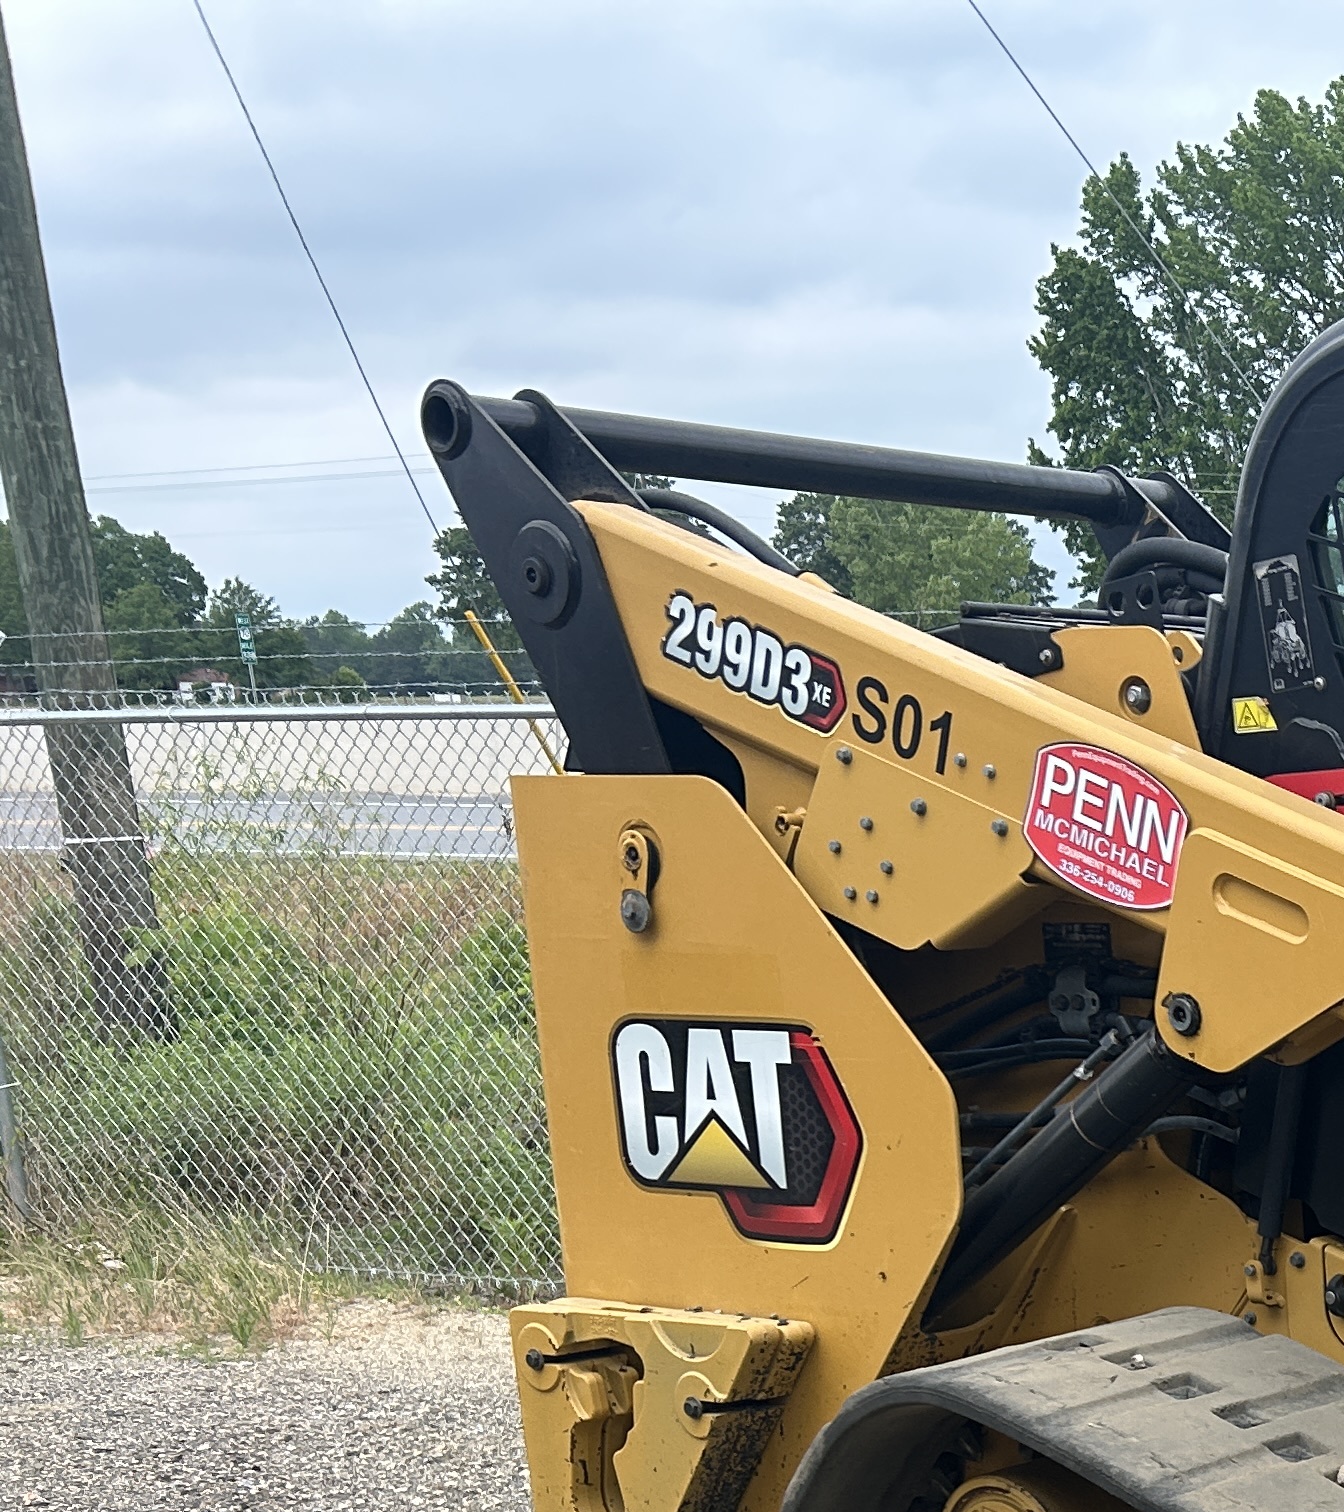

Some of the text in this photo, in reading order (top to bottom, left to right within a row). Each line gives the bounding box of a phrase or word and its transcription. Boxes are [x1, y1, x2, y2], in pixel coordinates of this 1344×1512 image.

[664, 594, 832, 716] 299D3 XE
[852, 676, 952, 775] S01
[1033, 808, 1170, 887] MCMICHAEL
[1040, 754, 1180, 865] PENN
[616, 1023, 792, 1189] CAT
